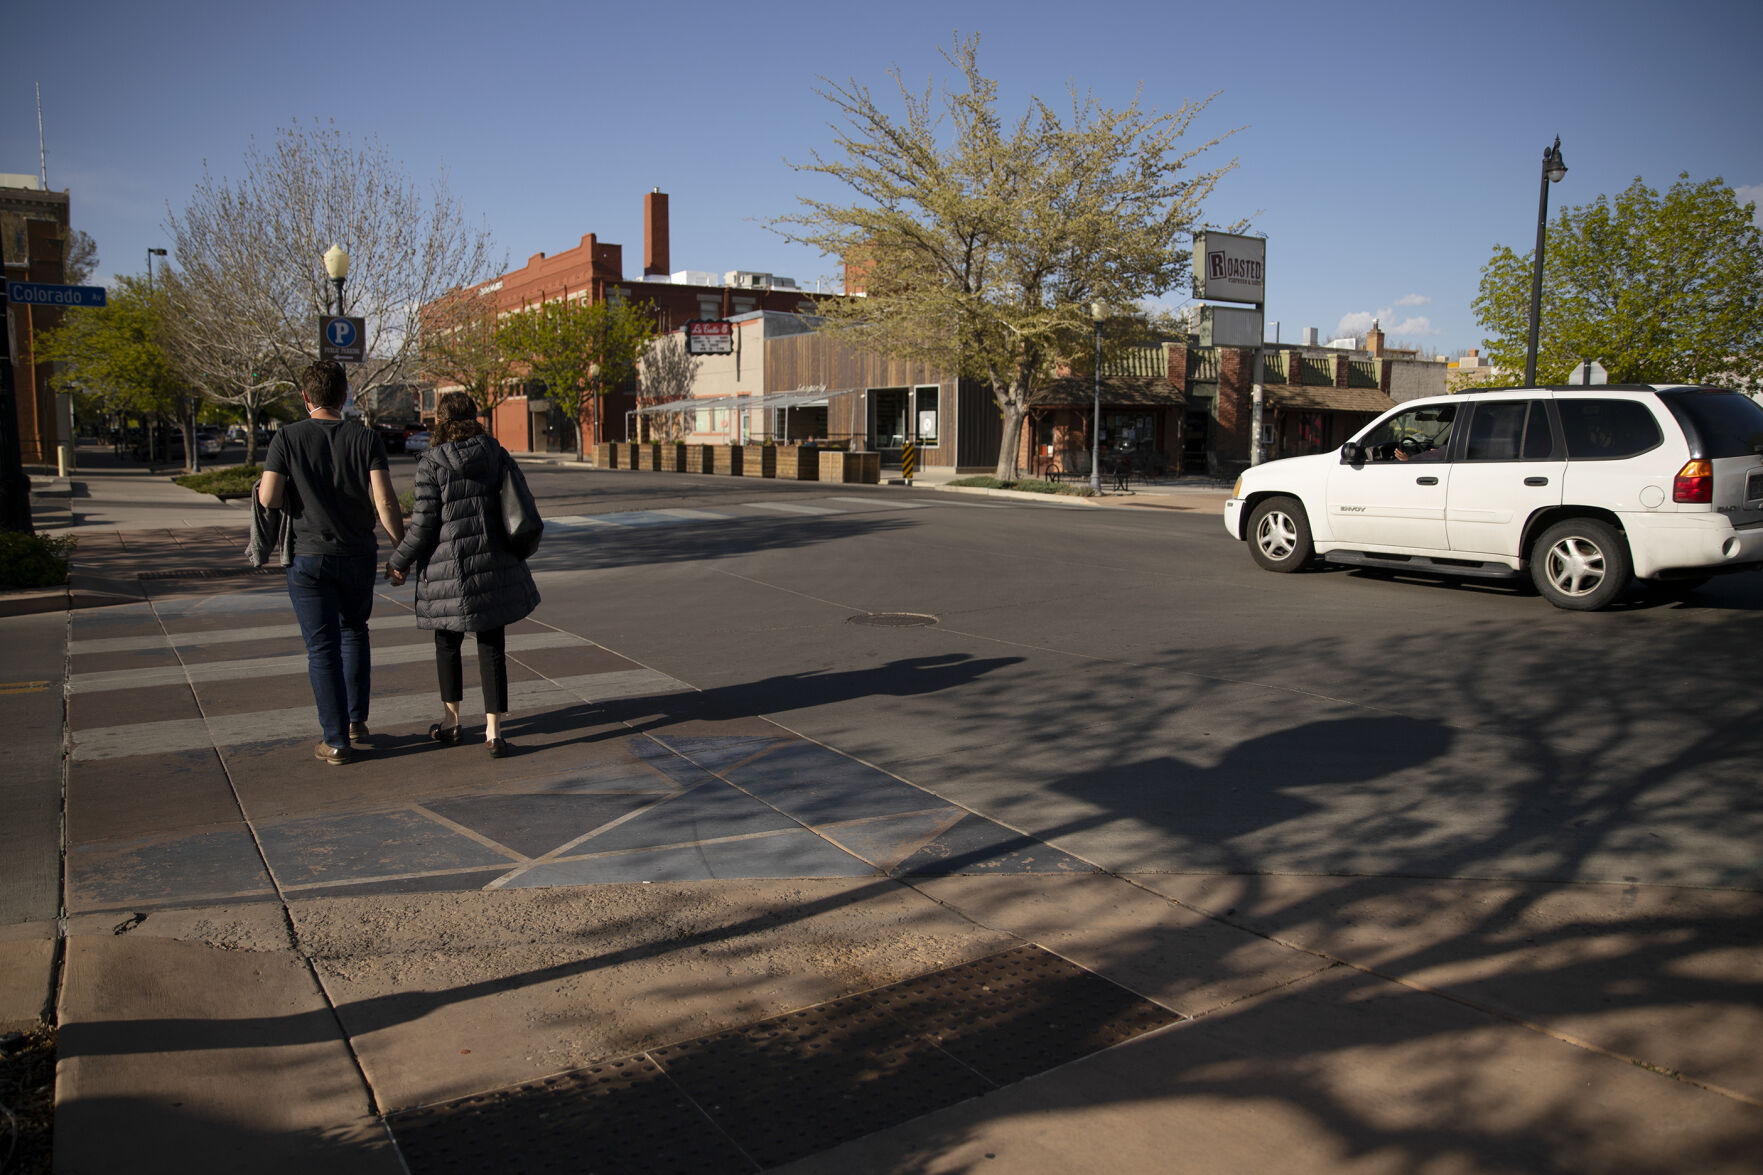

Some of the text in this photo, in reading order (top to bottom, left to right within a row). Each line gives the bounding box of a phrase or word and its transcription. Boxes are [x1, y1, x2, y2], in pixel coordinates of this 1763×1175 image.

[1208, 251, 1261, 280] ROASTED
[13, 284, 82, 303] Colorado
[334, 322, 349, 343] P
